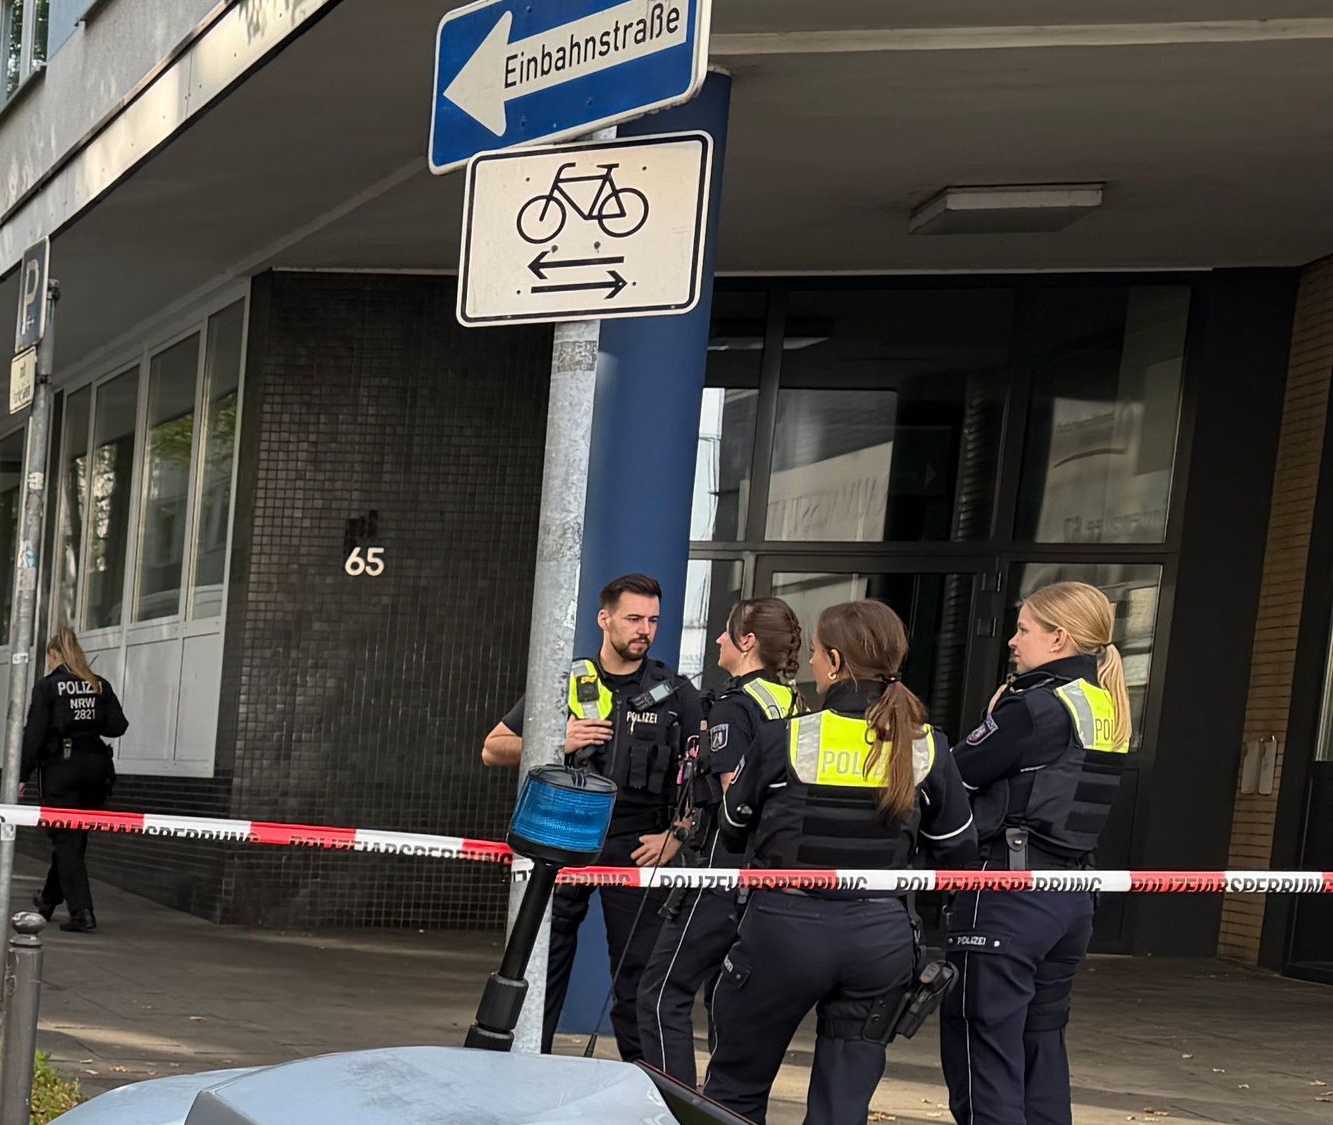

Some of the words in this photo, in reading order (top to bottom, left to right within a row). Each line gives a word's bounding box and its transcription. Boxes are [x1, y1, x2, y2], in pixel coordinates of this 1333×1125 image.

[503, 2, 680, 89] Einbahnstraße
[345, 546, 385, 577] 65
[70, 697, 96, 710] NRW
[73, 709, 96, 721] 2821
[626, 711, 658, 724] POLIZEI
